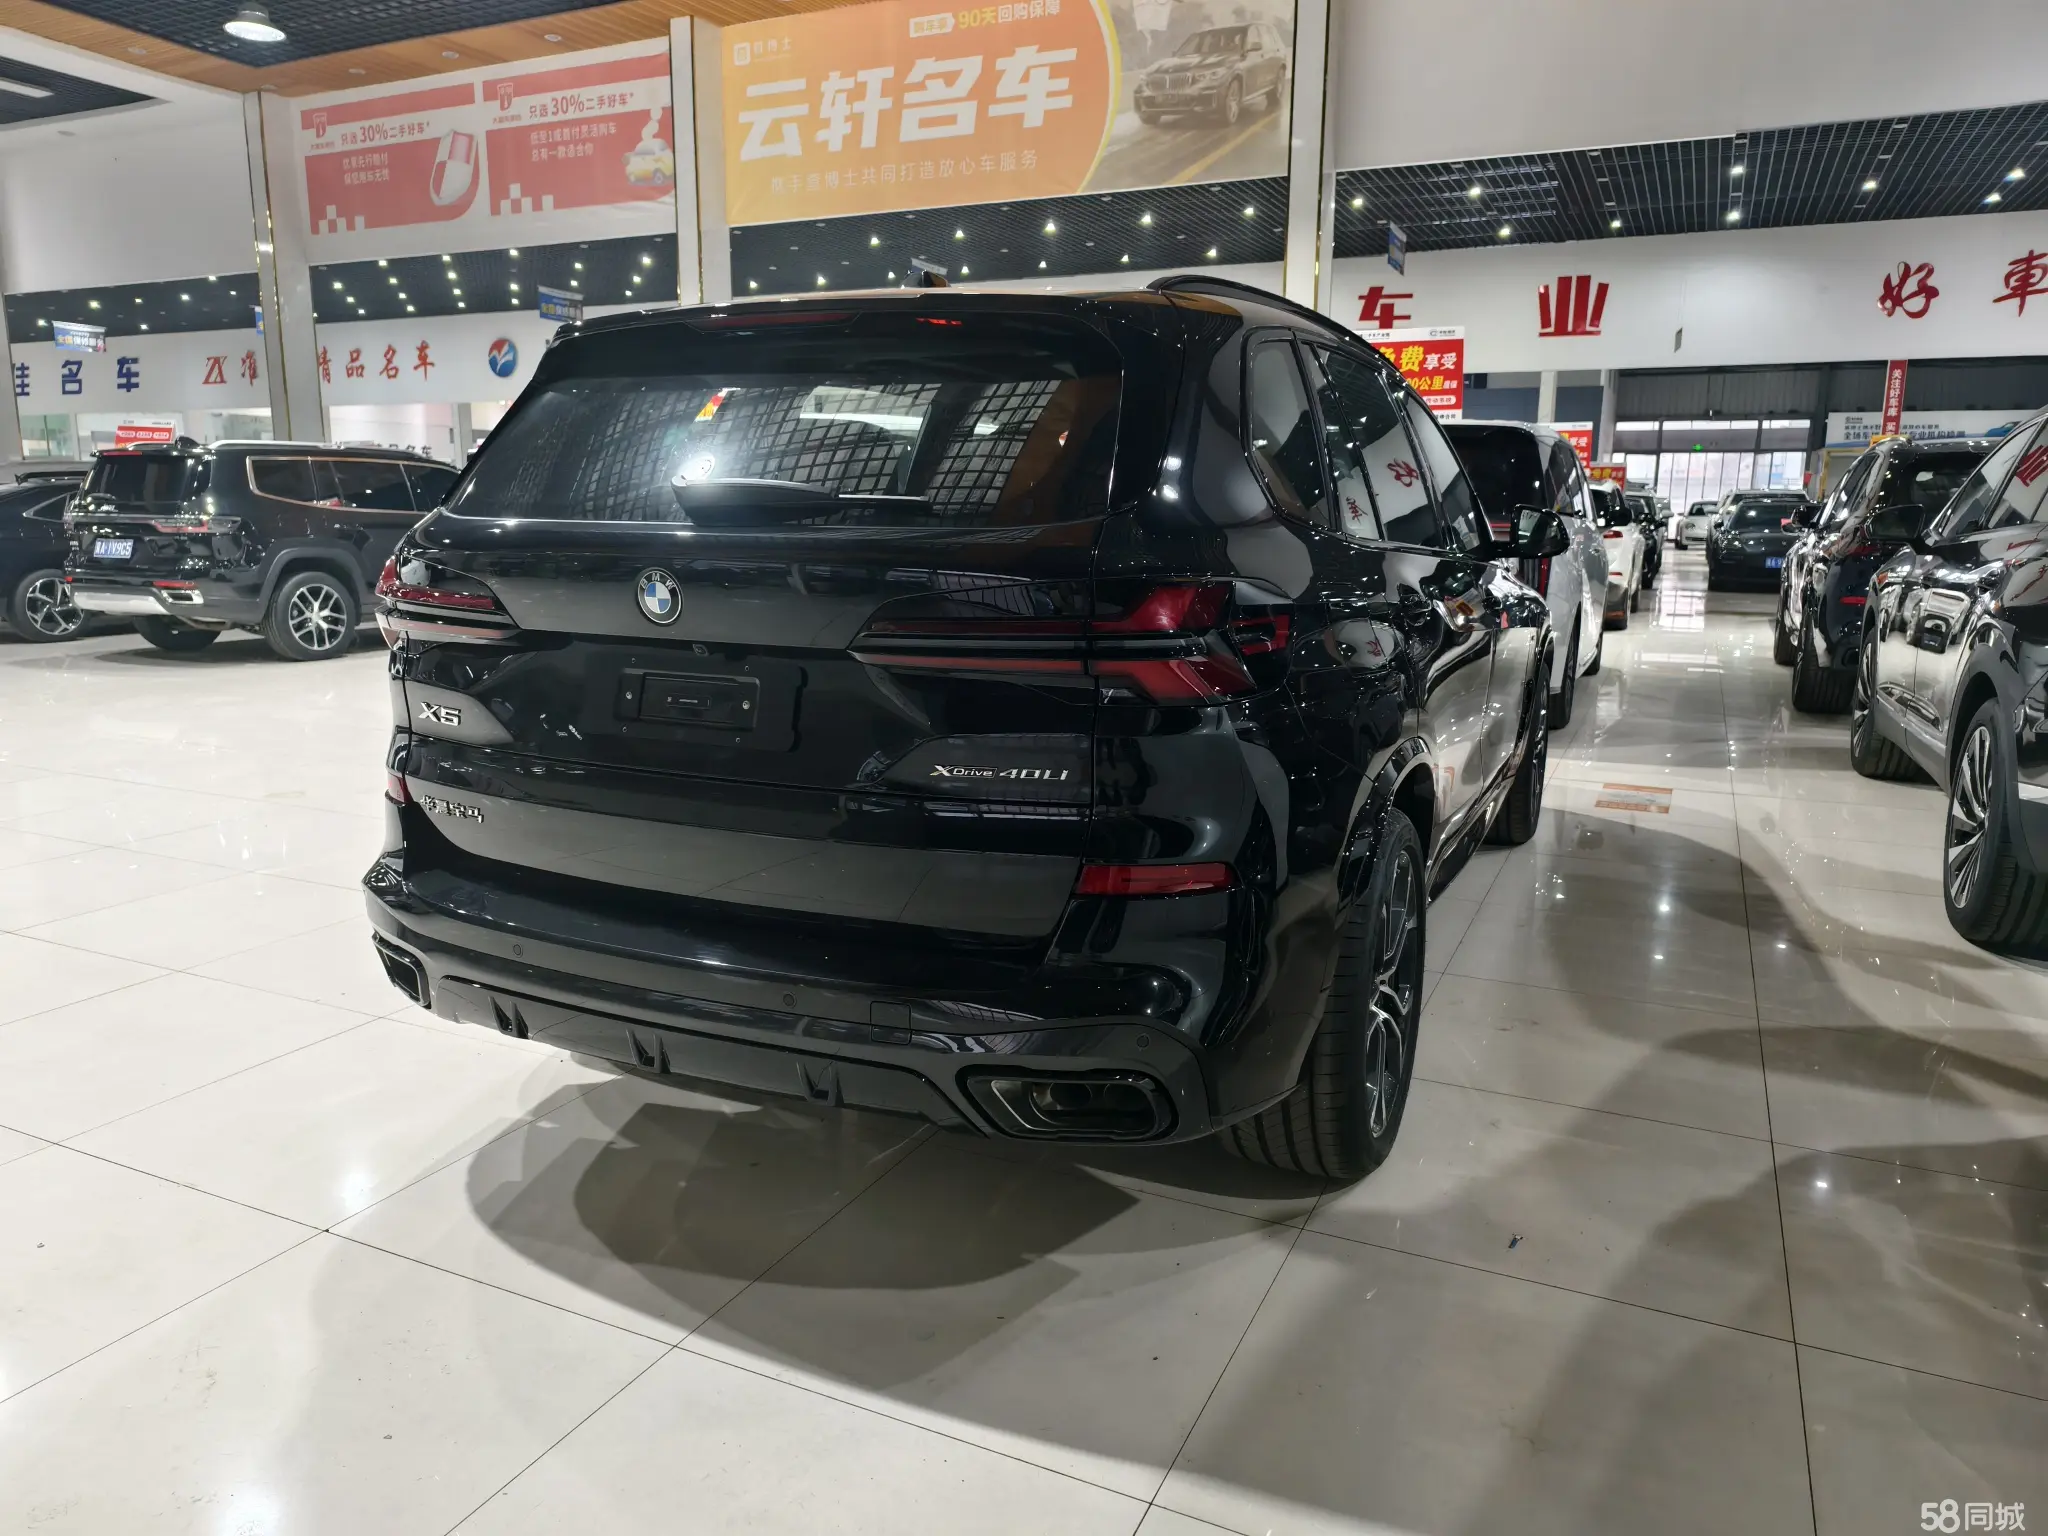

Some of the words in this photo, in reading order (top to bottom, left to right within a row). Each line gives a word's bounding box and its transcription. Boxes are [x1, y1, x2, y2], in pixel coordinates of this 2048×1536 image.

[738, 45, 1077, 162] 云轩名车
[419, 701, 461, 727] X5
